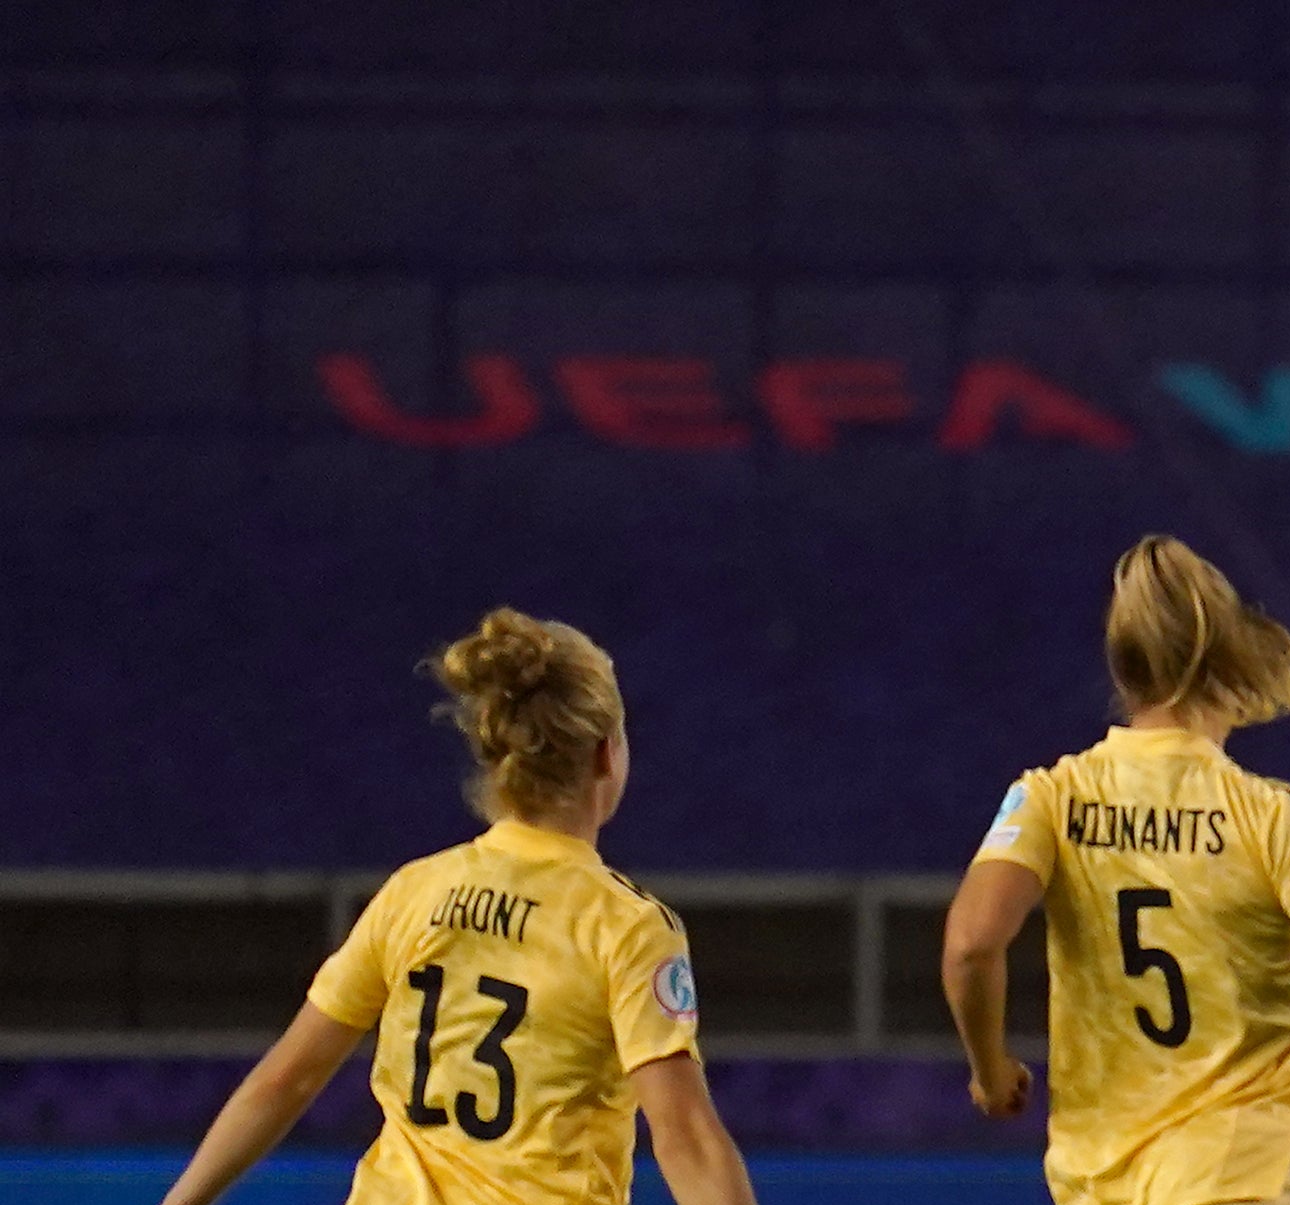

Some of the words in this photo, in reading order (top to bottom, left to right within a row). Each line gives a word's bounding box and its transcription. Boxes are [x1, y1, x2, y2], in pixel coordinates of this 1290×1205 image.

[318, 353, 1137, 452] UEFA
[1117, 887, 1192, 1049] 5
[406, 963, 529, 1142] 13
